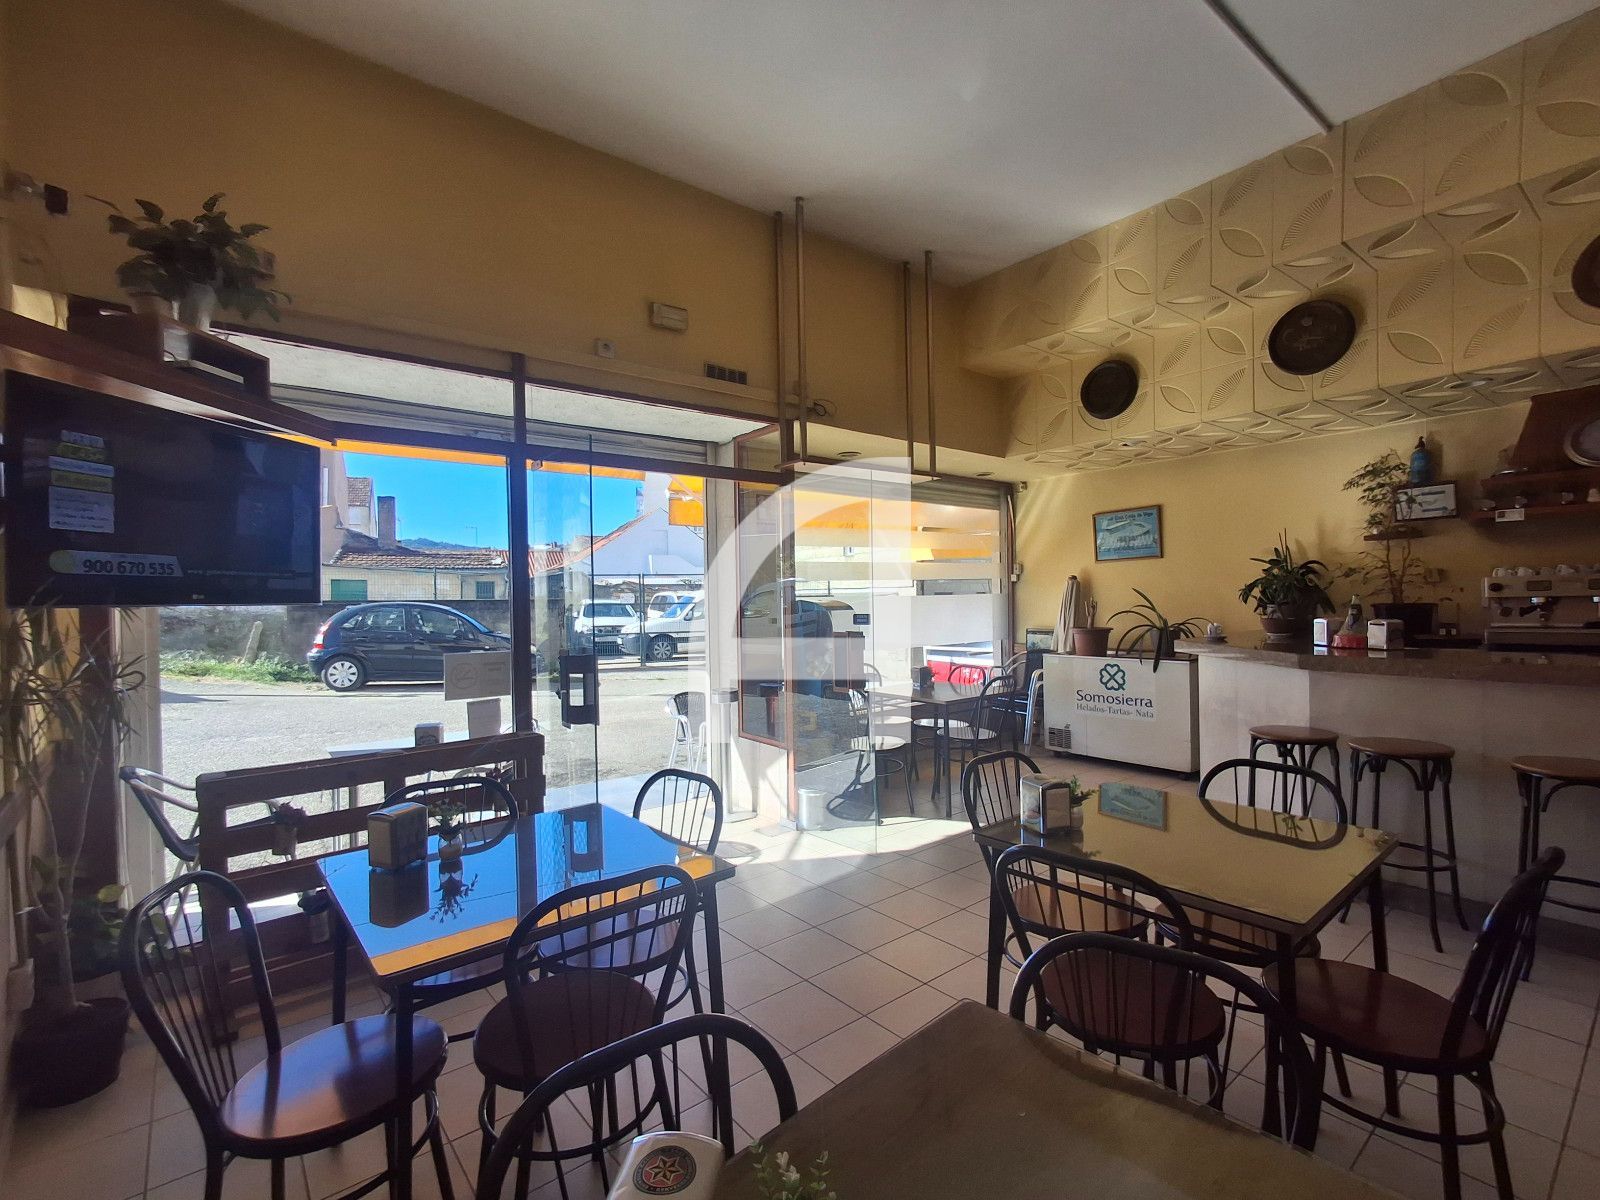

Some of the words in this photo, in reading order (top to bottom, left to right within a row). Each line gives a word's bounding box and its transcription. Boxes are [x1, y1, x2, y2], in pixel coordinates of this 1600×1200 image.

[83, 559, 113, 573] 900
[117, 560, 145, 575] 670
[149, 562, 174, 575] 535
[1077, 690, 1153, 708] Somosierra
[1136, 709, 1154, 718] Nata
